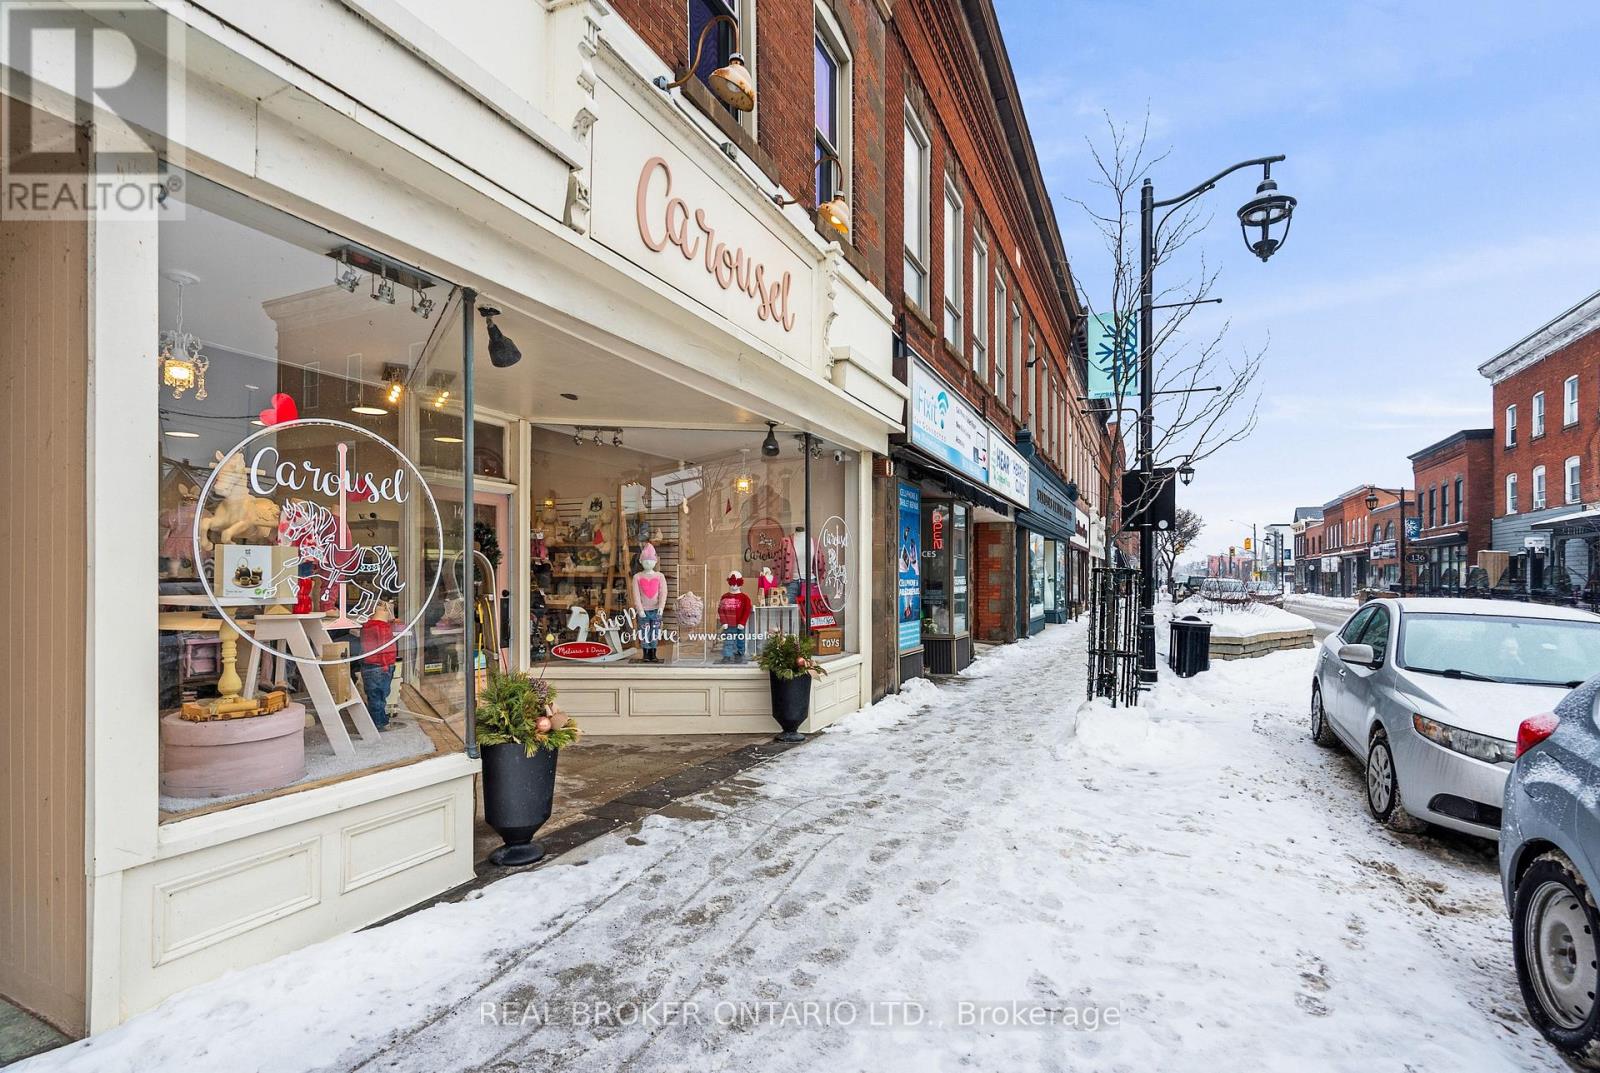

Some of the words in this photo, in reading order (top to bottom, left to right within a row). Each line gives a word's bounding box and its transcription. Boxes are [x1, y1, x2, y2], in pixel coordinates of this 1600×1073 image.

[636, 156, 796, 332] Carousel
[250, 446, 410, 504] Carousel
[620, 622, 680, 644] online
[688, 631, 799, 641] www.carousel
[821, 638, 840, 648] TOYS
